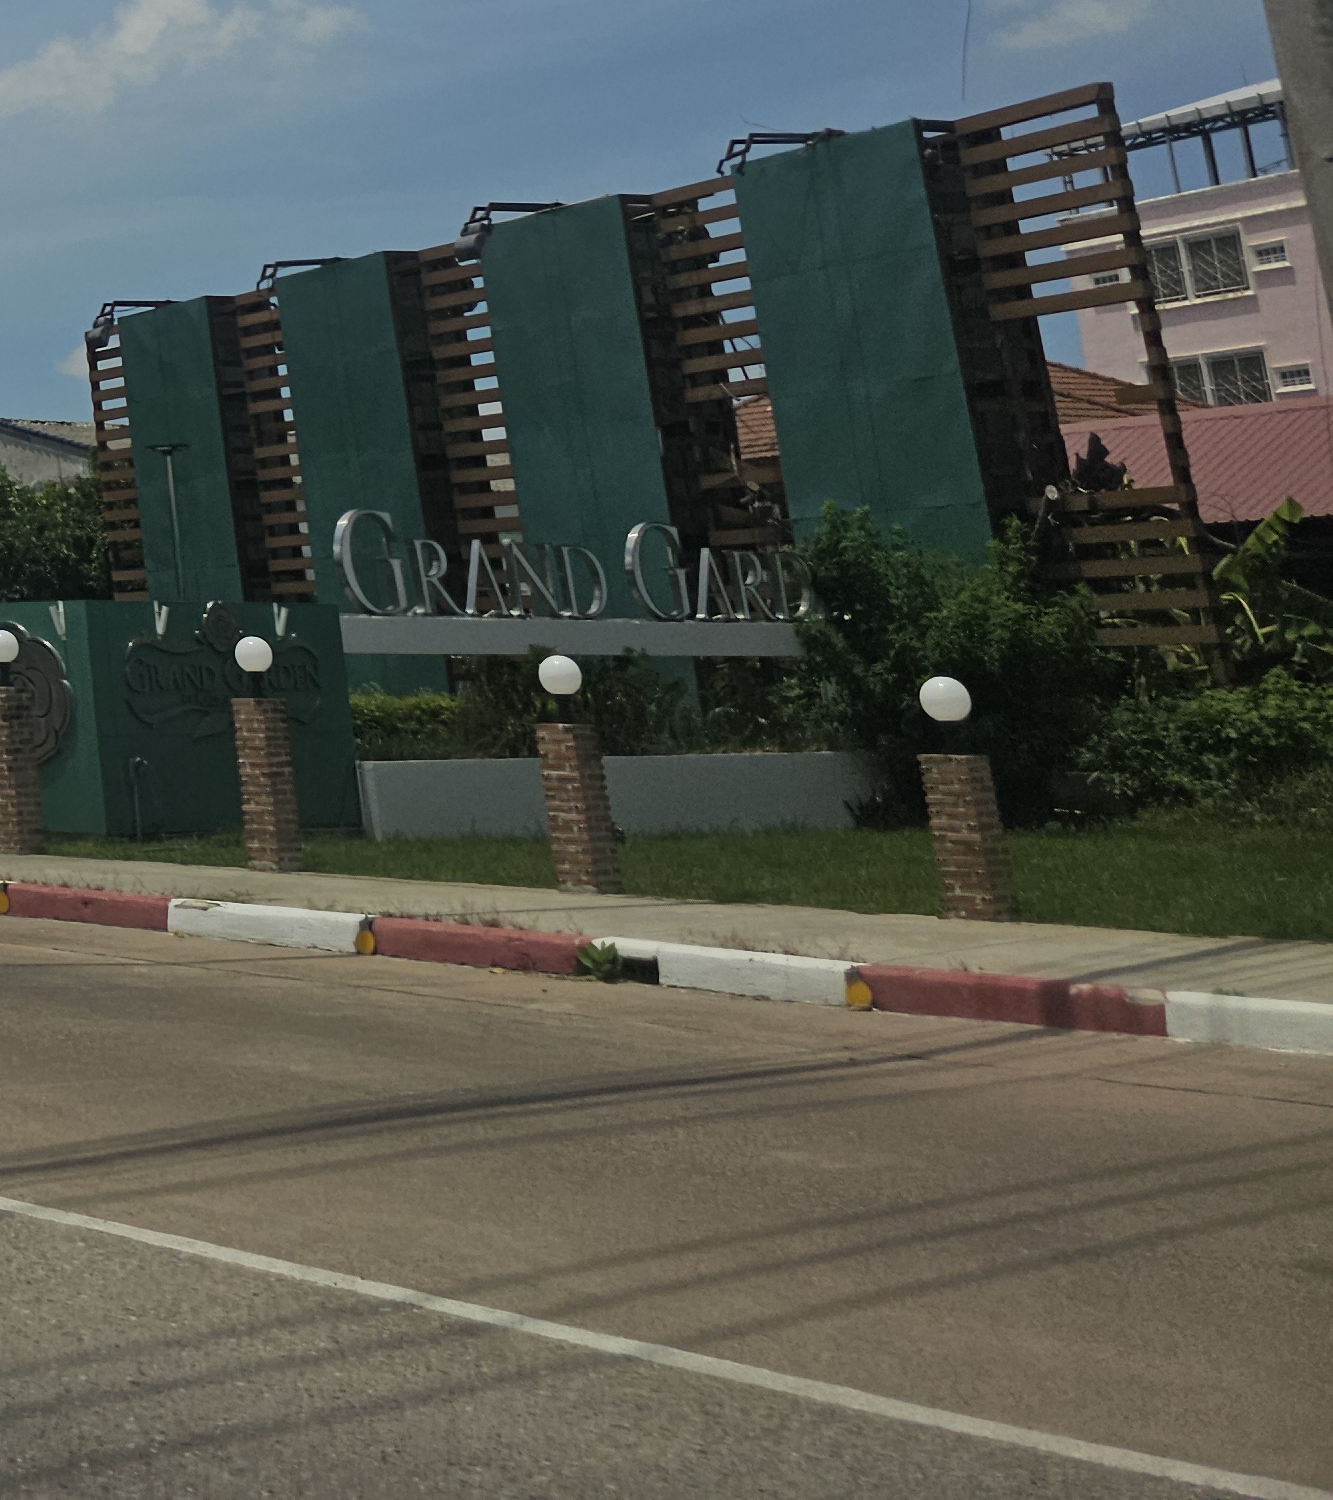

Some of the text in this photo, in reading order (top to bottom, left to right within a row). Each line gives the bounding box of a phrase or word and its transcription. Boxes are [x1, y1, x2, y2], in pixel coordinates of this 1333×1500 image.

[333, 508, 815, 622] GRAND GARD
[126, 656, 322, 694] GRAND GRDEN
